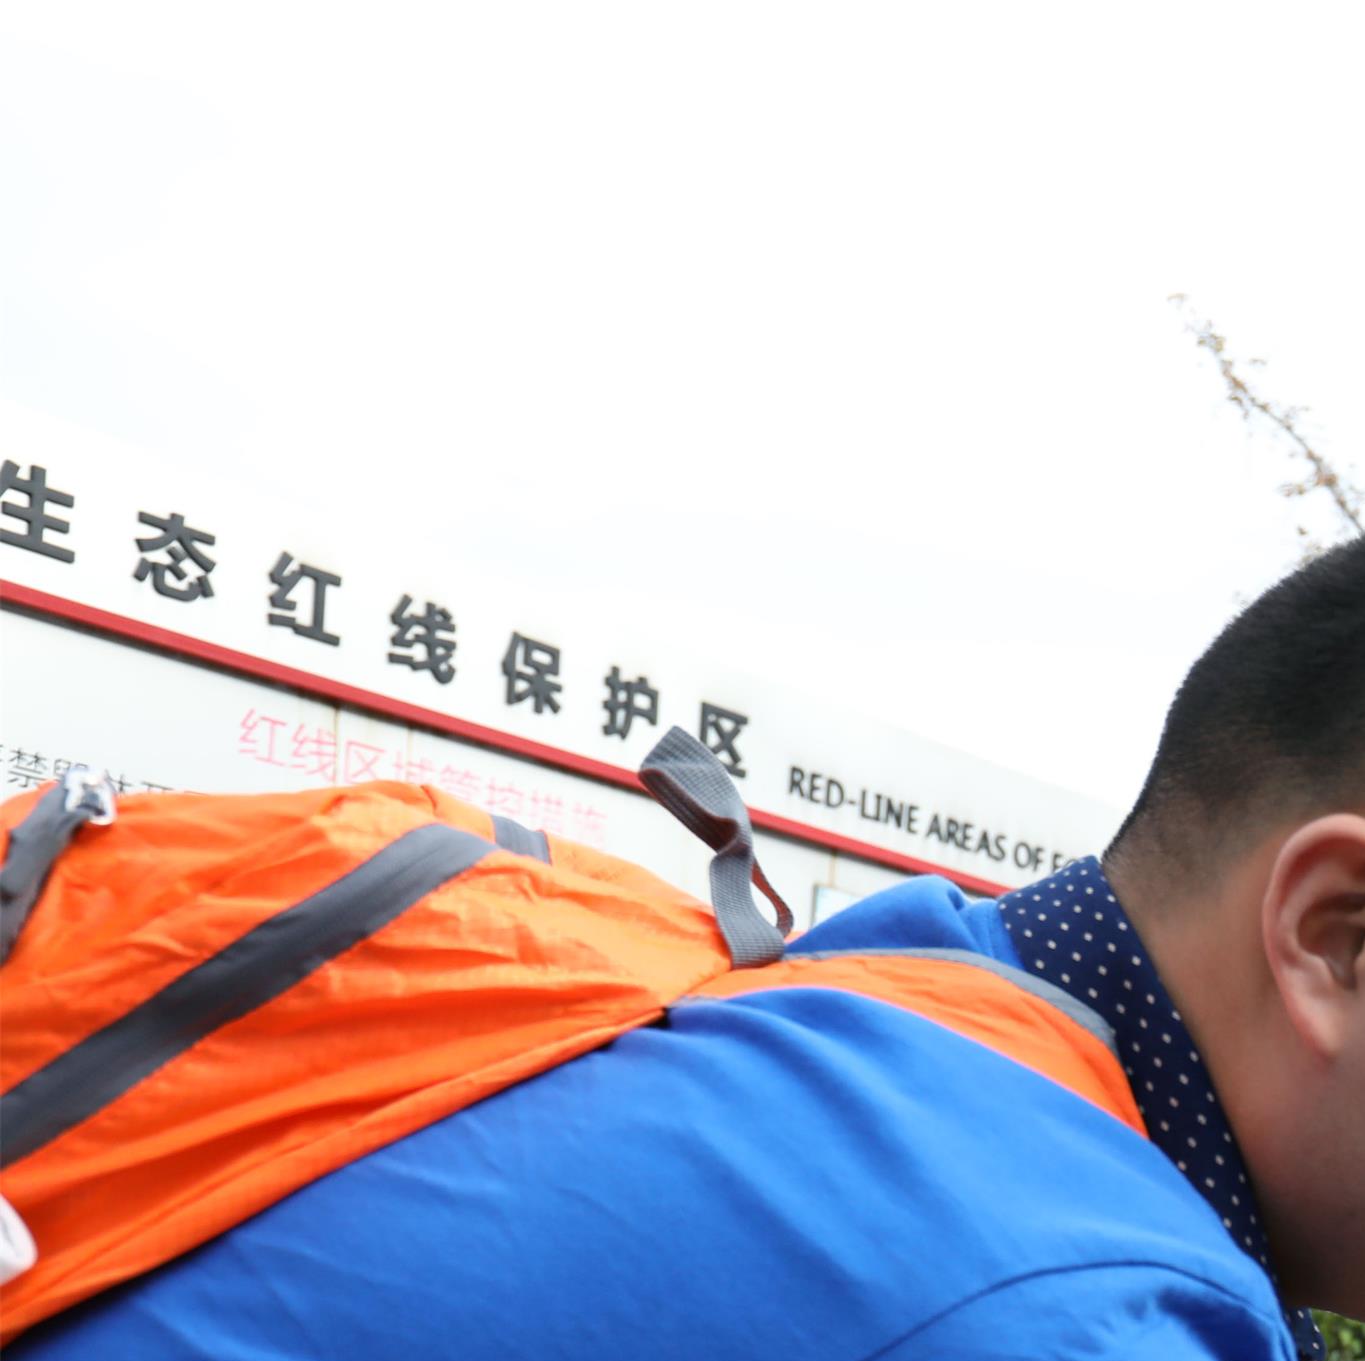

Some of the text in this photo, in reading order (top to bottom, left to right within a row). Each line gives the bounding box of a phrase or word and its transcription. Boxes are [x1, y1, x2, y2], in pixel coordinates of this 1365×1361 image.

[0, 459, 748, 778] 生态红线保护区
[788, 765, 920, 834] RED-LINE
[925, 812, 1007, 862] AREAS
[1013, 841, 1045, 872] OF
